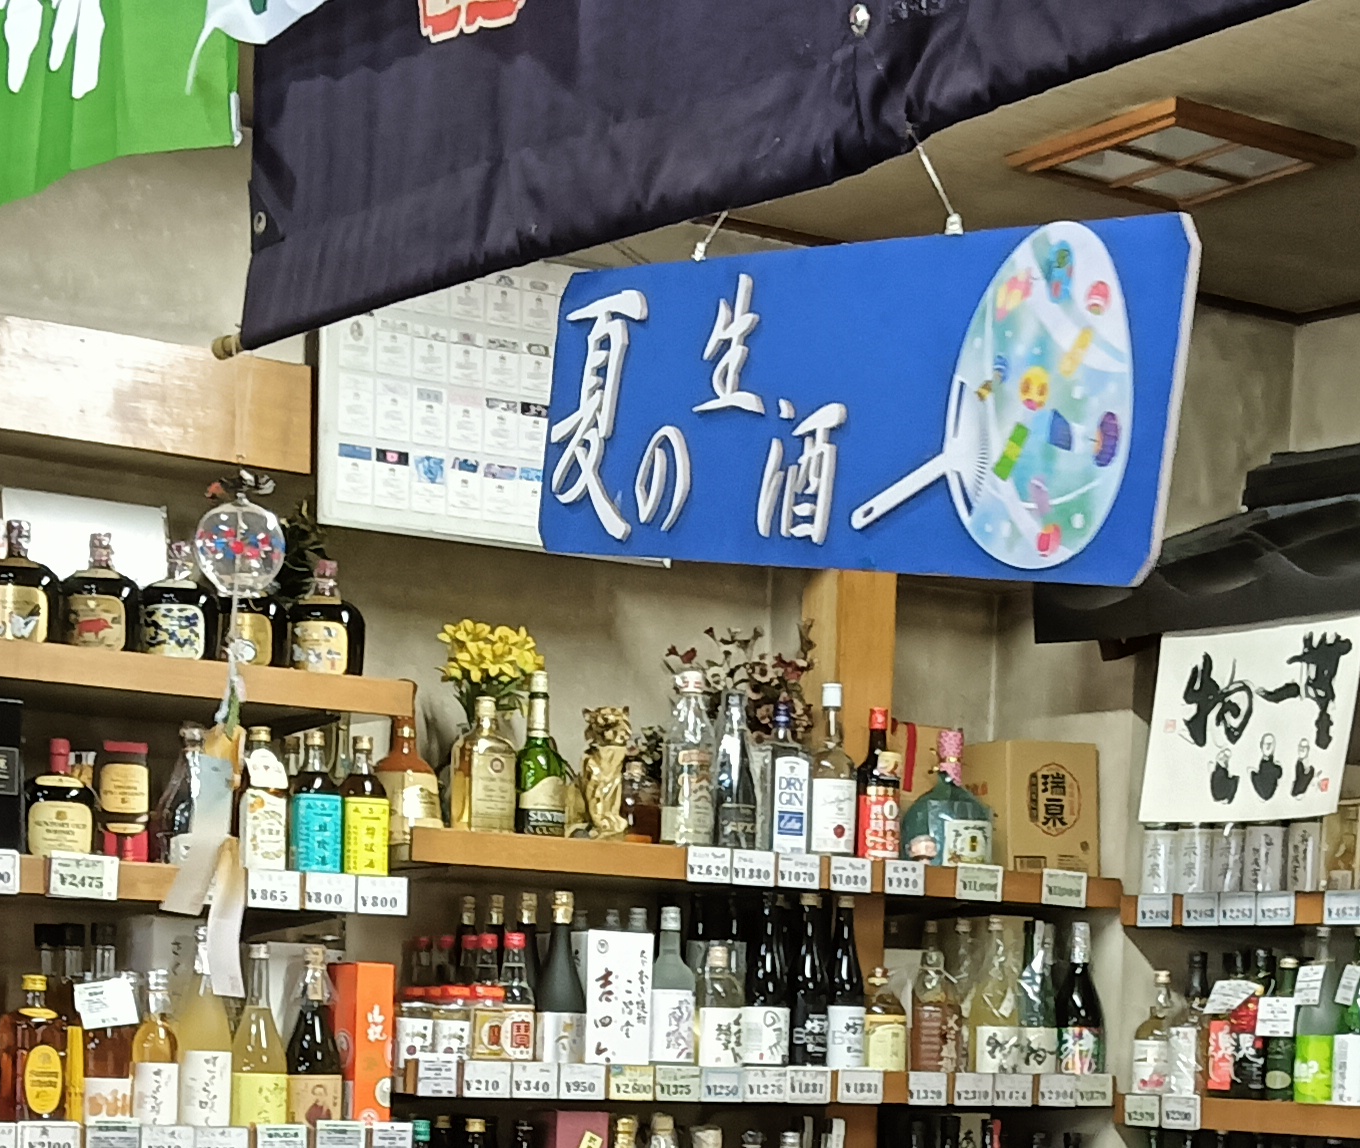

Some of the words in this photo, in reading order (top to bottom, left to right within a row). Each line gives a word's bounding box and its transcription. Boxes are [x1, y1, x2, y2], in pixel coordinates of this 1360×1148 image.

[778, 776, 807, 791] DRY
[779, 792, 805, 808] GIN
[250, 889, 289, 904] ¥865
[305, 891, 344, 906] ¥800
[360, 895, 399, 910] ¥800
[464, 1078, 500, 1093] ¥210
[513, 1079, 551, 1093] ¥340
[564, 1080, 597, 1094] ¥950
